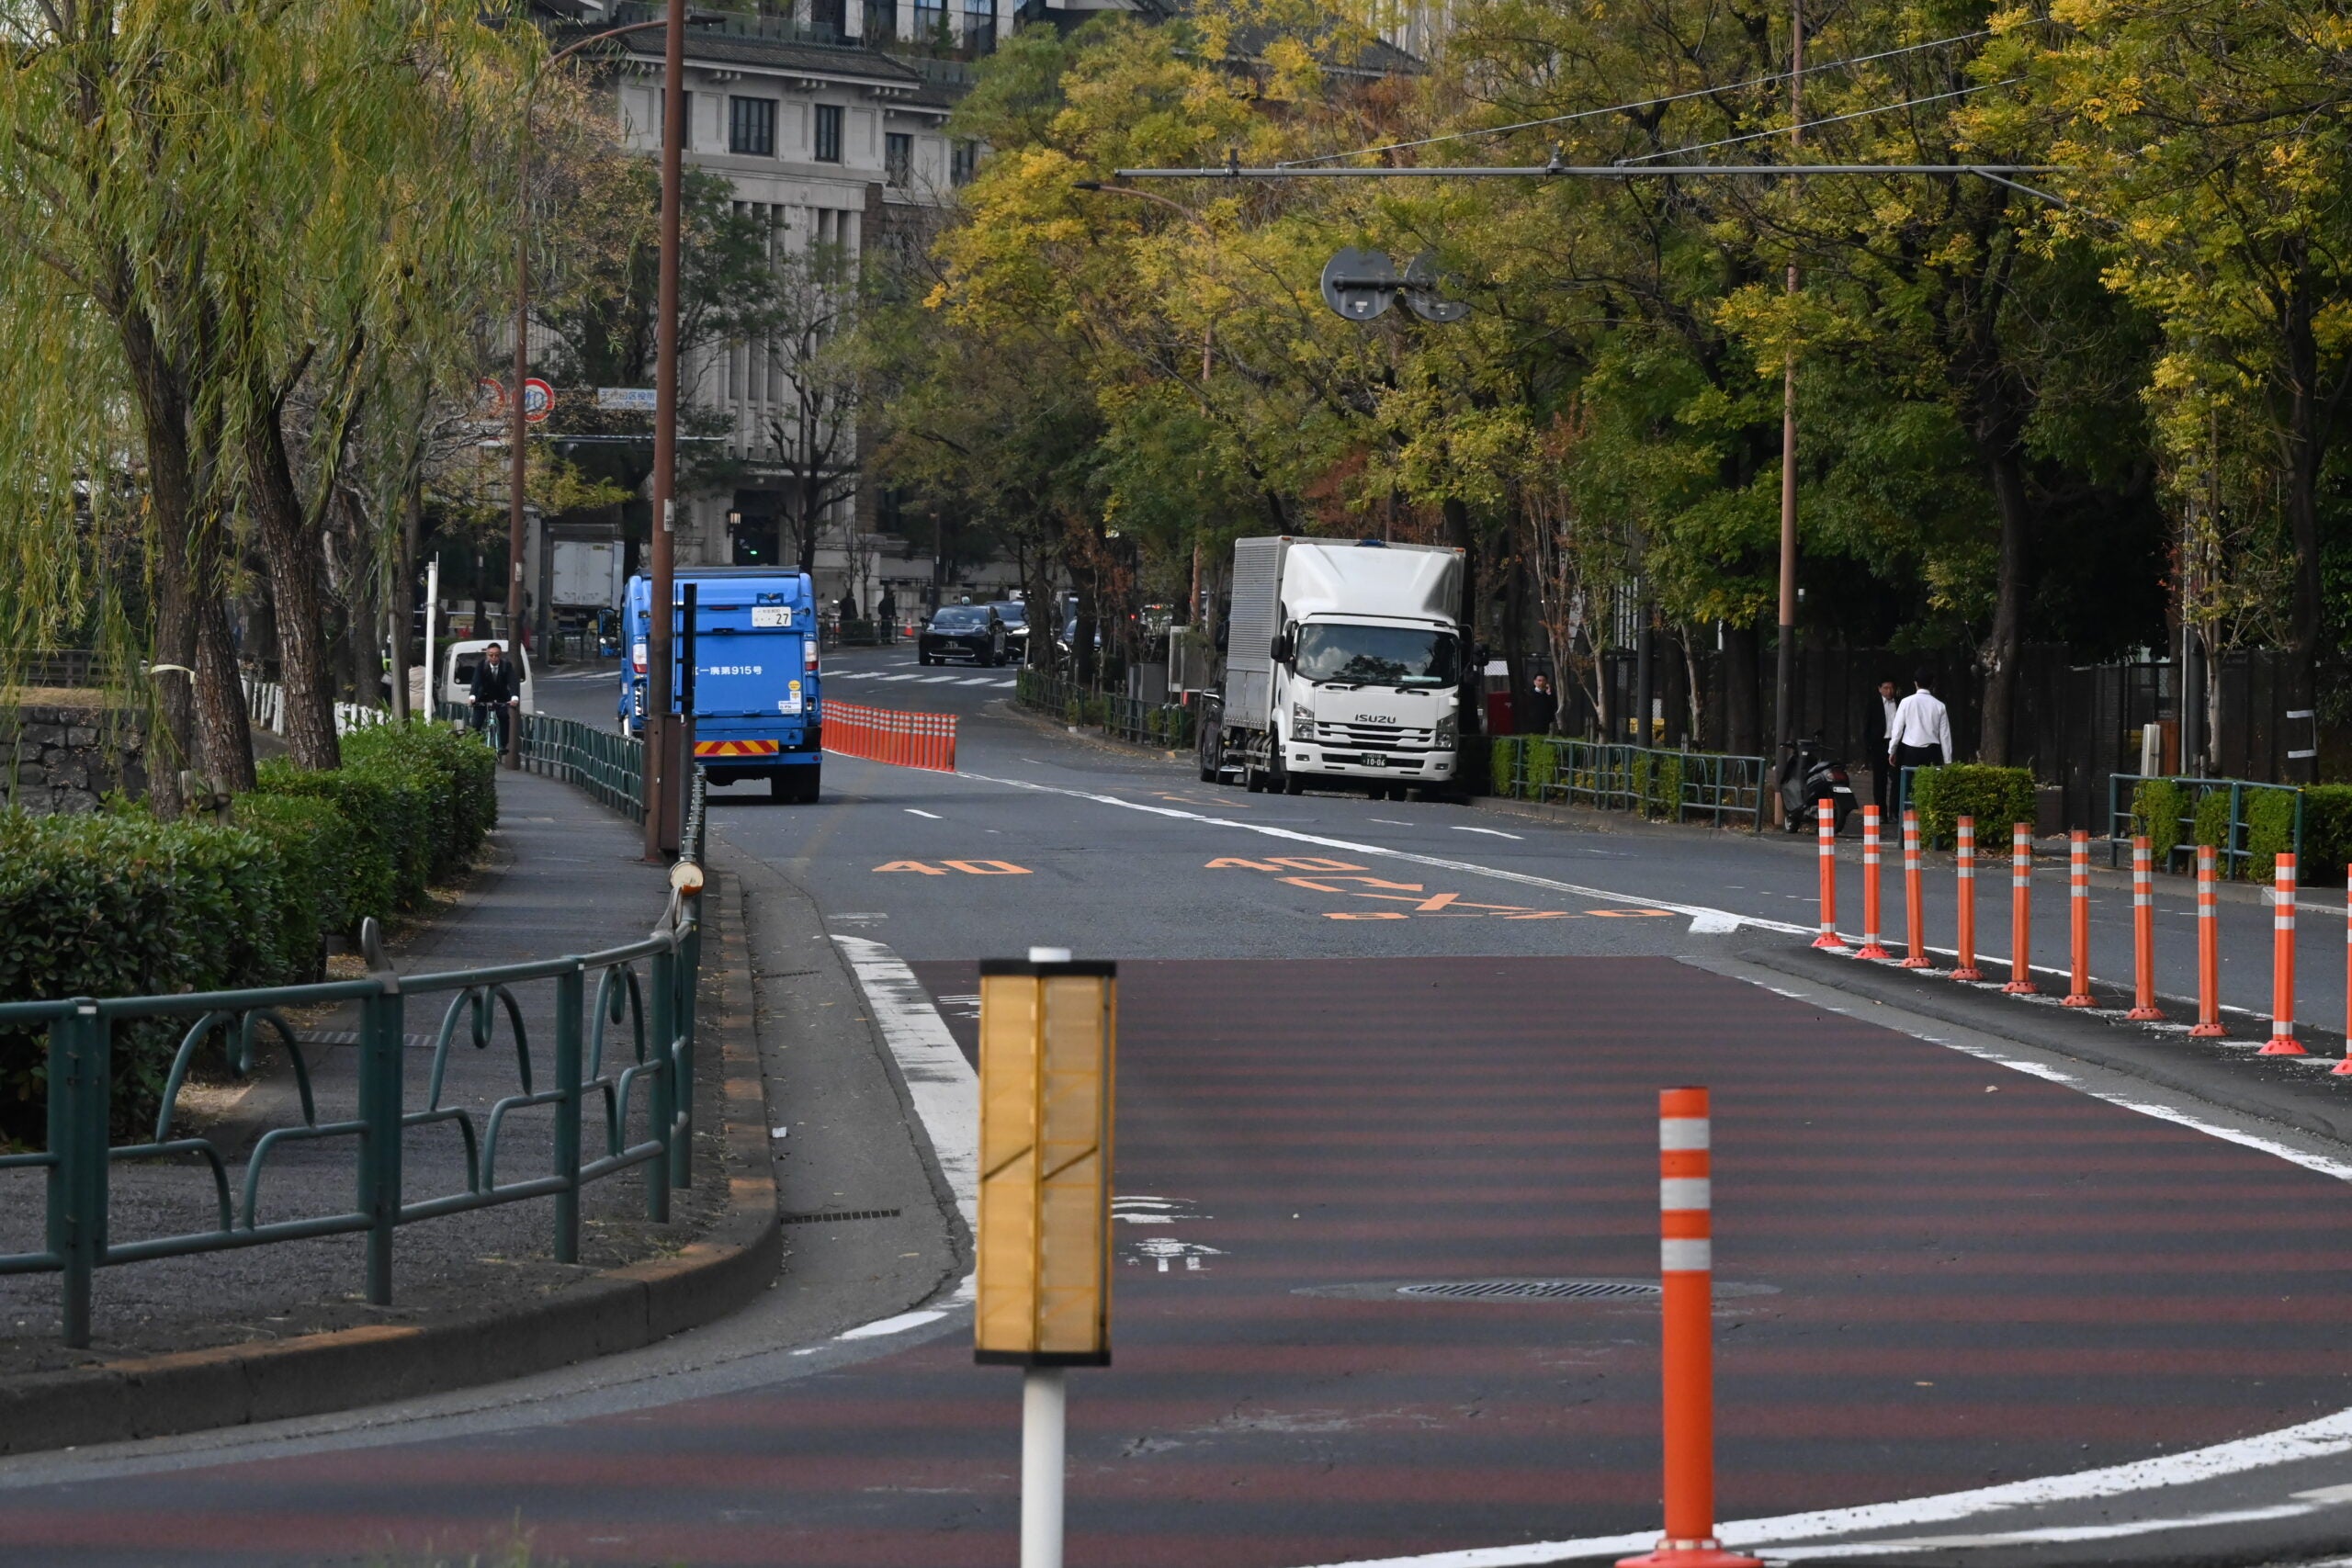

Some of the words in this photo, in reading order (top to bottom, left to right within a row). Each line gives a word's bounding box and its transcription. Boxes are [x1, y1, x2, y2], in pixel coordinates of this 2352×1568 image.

[1354, 714, 1396, 724] ISUZU
[872, 860, 1035, 875] 40
[1204, 857, 1371, 872] 40
